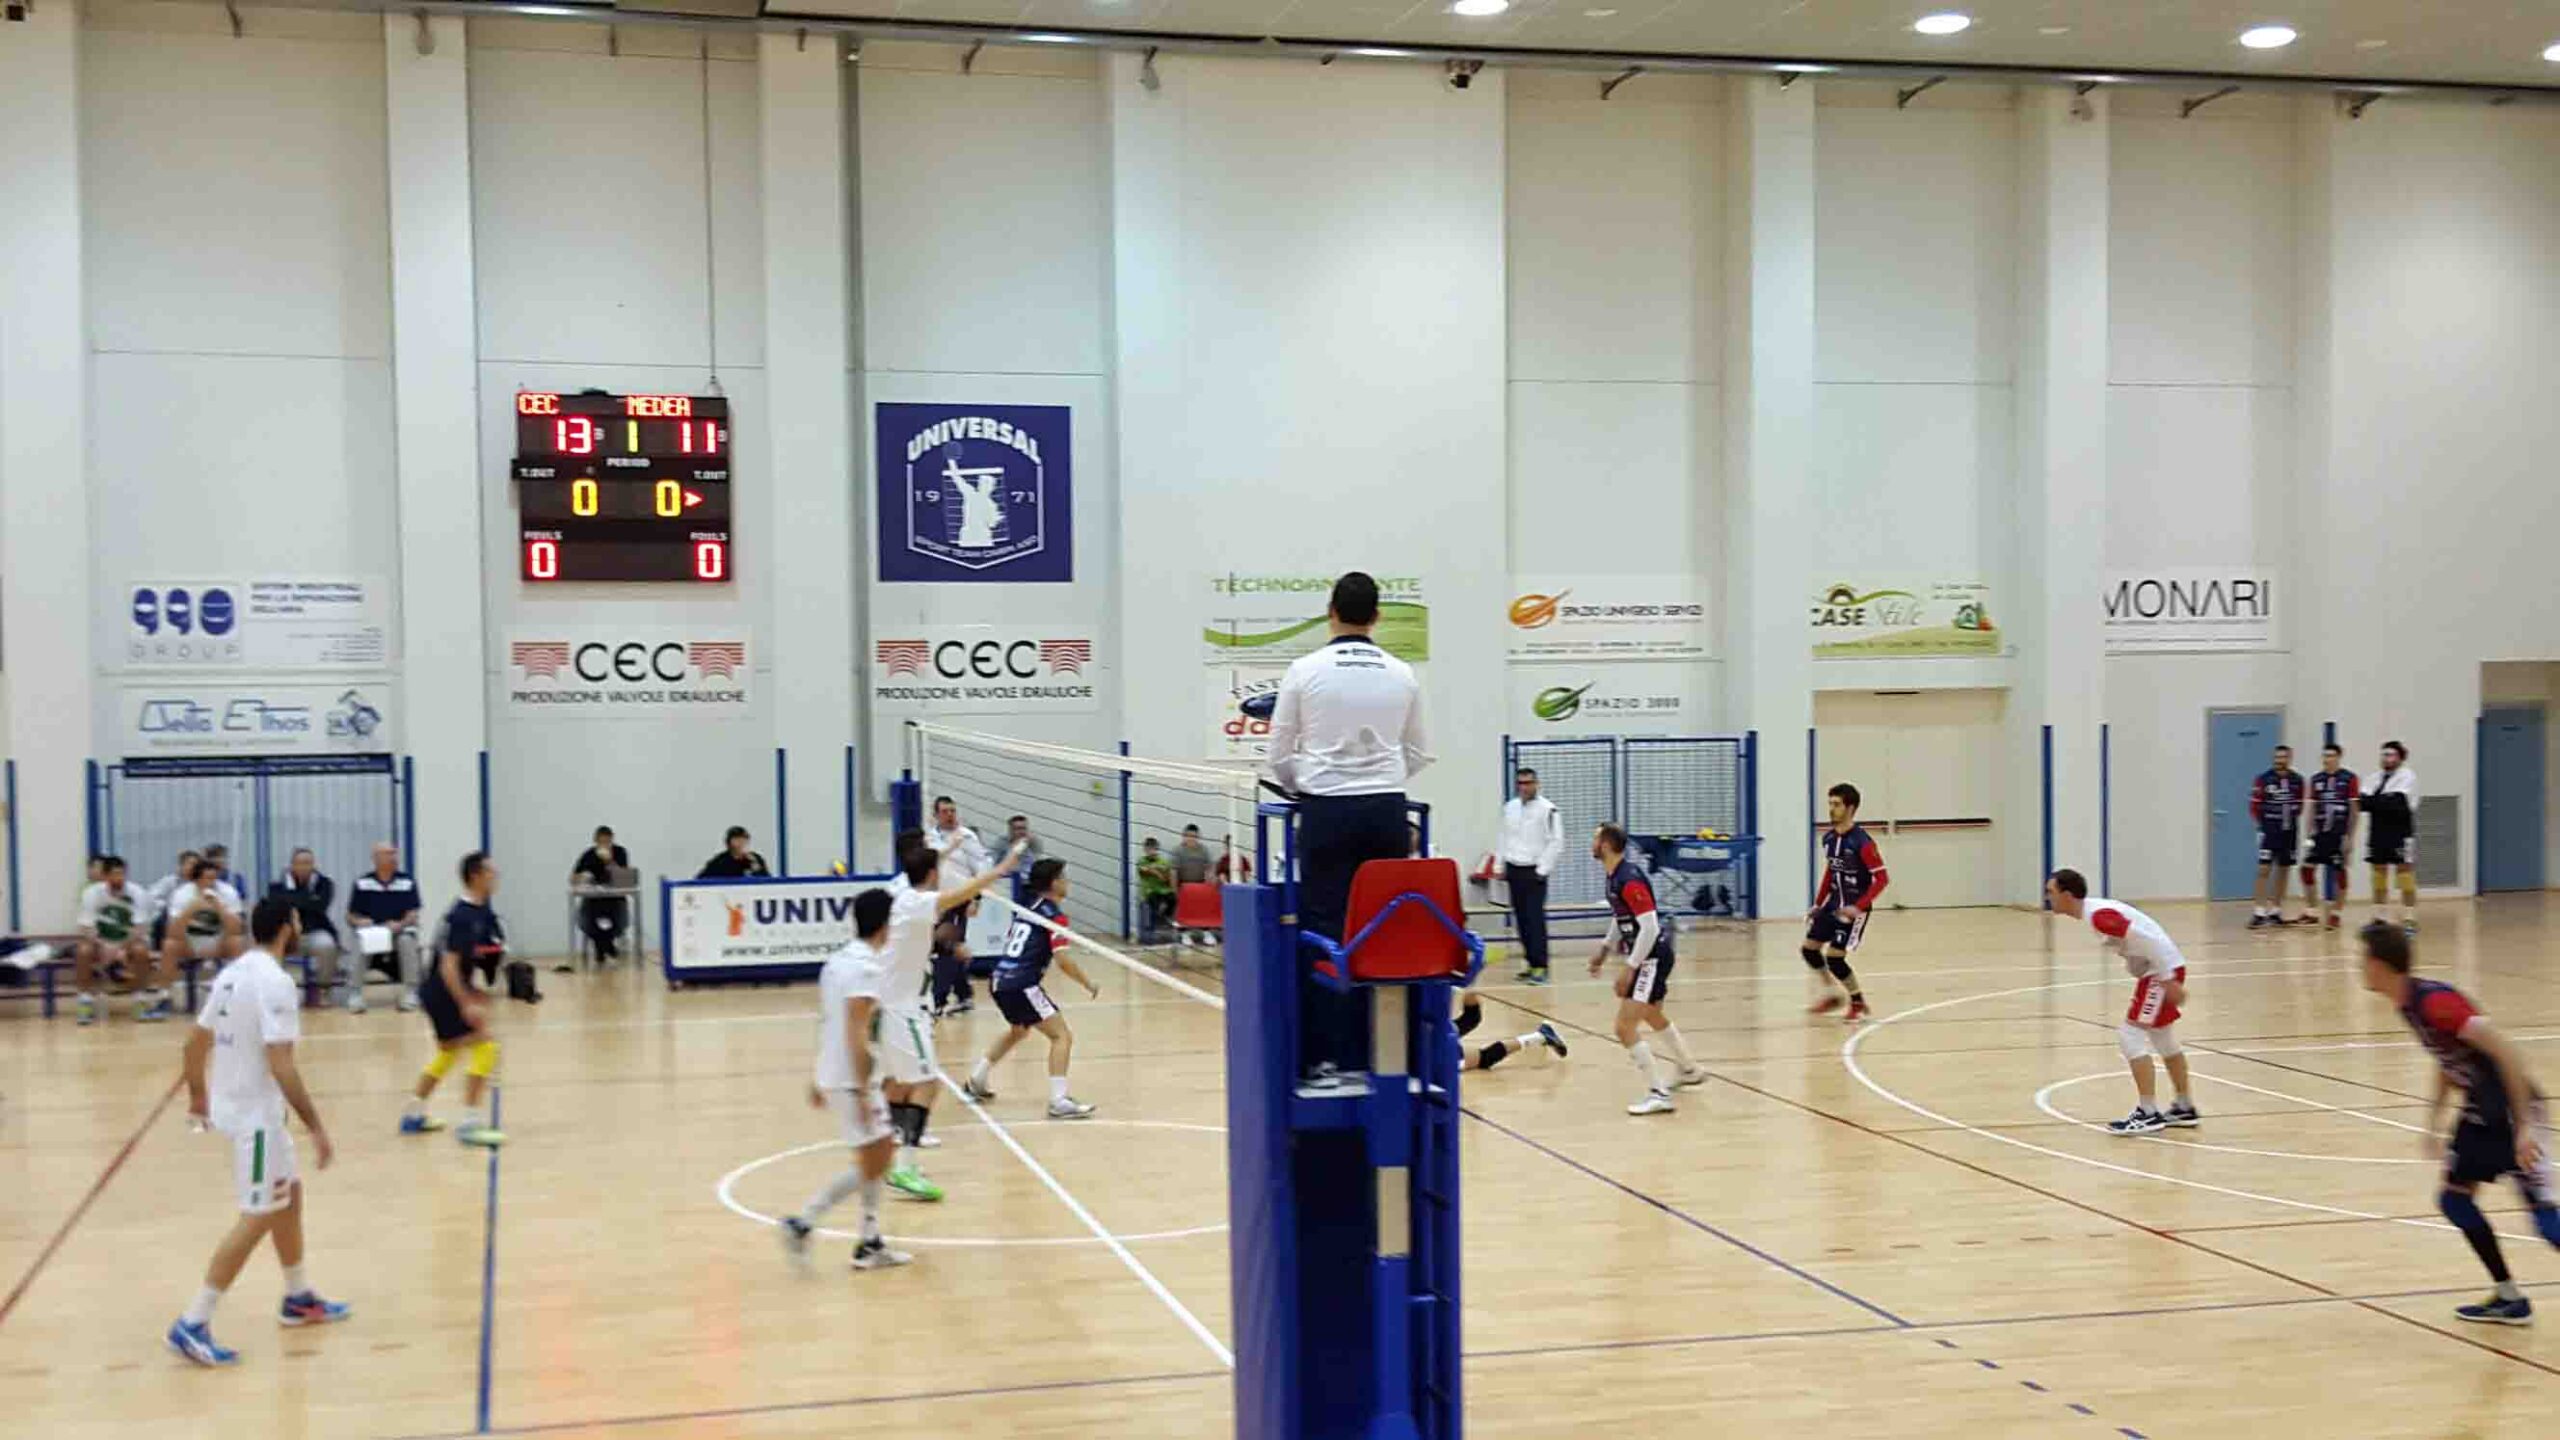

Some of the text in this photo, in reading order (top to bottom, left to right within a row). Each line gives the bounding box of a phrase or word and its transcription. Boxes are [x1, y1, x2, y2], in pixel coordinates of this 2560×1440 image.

[519, 394, 560, 415] CEC
[626, 396, 692, 417] MEDEA
[558, 417, 592, 454] 13
[628, 419, 639, 453] 1
[682, 421, 717, 454] 11
[906, 416, 1042, 464] UNIVERSAL
[573, 479, 598, 516] 0
[656, 480, 681, 517] 0
[531, 542, 556, 578] 0
[698, 543, 722, 578] 0
[2103, 579, 2270, 618] MONARI
[575, 642, 686, 682] CEC
[934, 640, 1037, 679] CEC
[511, 690, 601, 703] PRODUZIONE
[607, 690, 664, 702] VALVOLE
[876, 687, 960, 699] PRODUZIONE
[963, 687, 1018, 699] VALVOLE
